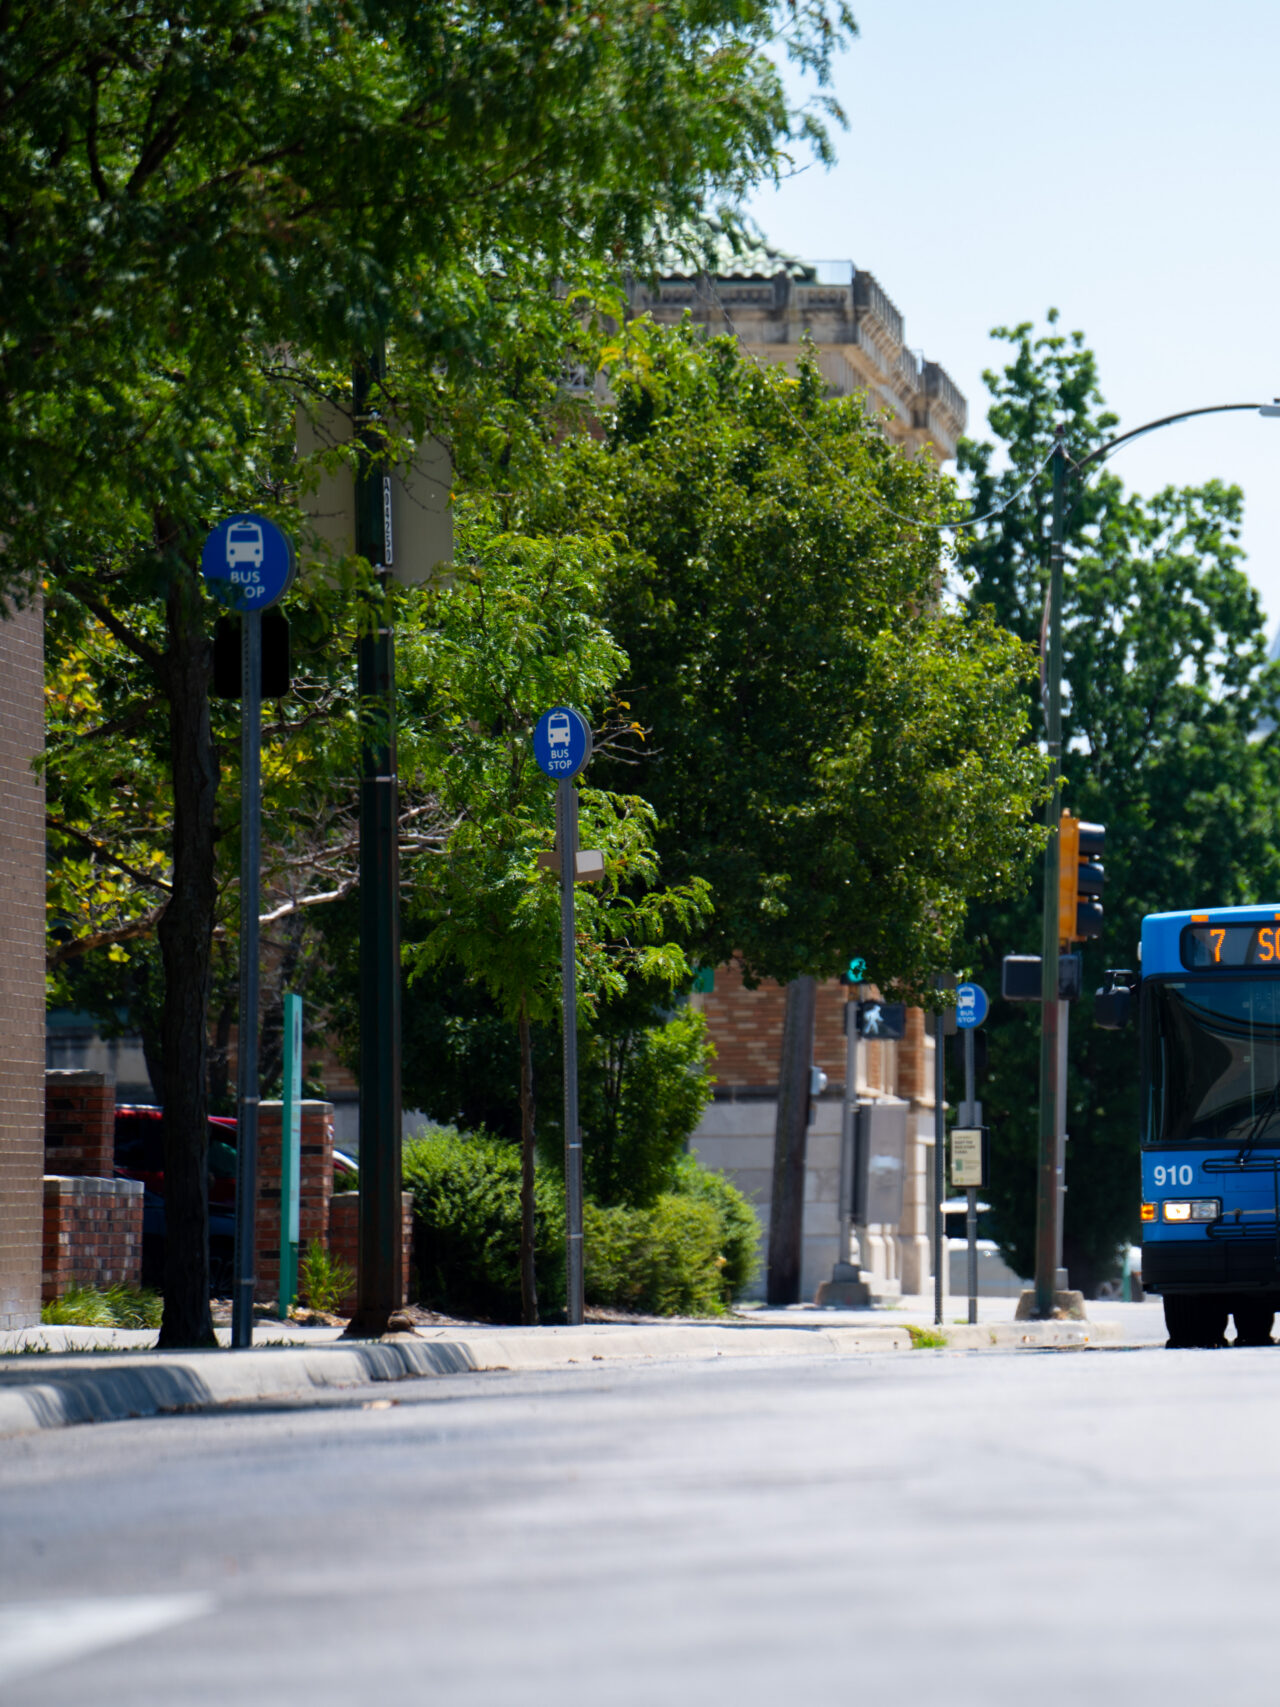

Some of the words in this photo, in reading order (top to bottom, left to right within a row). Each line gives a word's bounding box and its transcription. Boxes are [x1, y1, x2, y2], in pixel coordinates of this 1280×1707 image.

[230, 571, 260, 583] BUS
[551, 749, 569, 759] BUS
[548, 760, 572, 770] STOP
[1210, 929, 1226, 962] 7
[1154, 1165, 1193, 1186] 910
